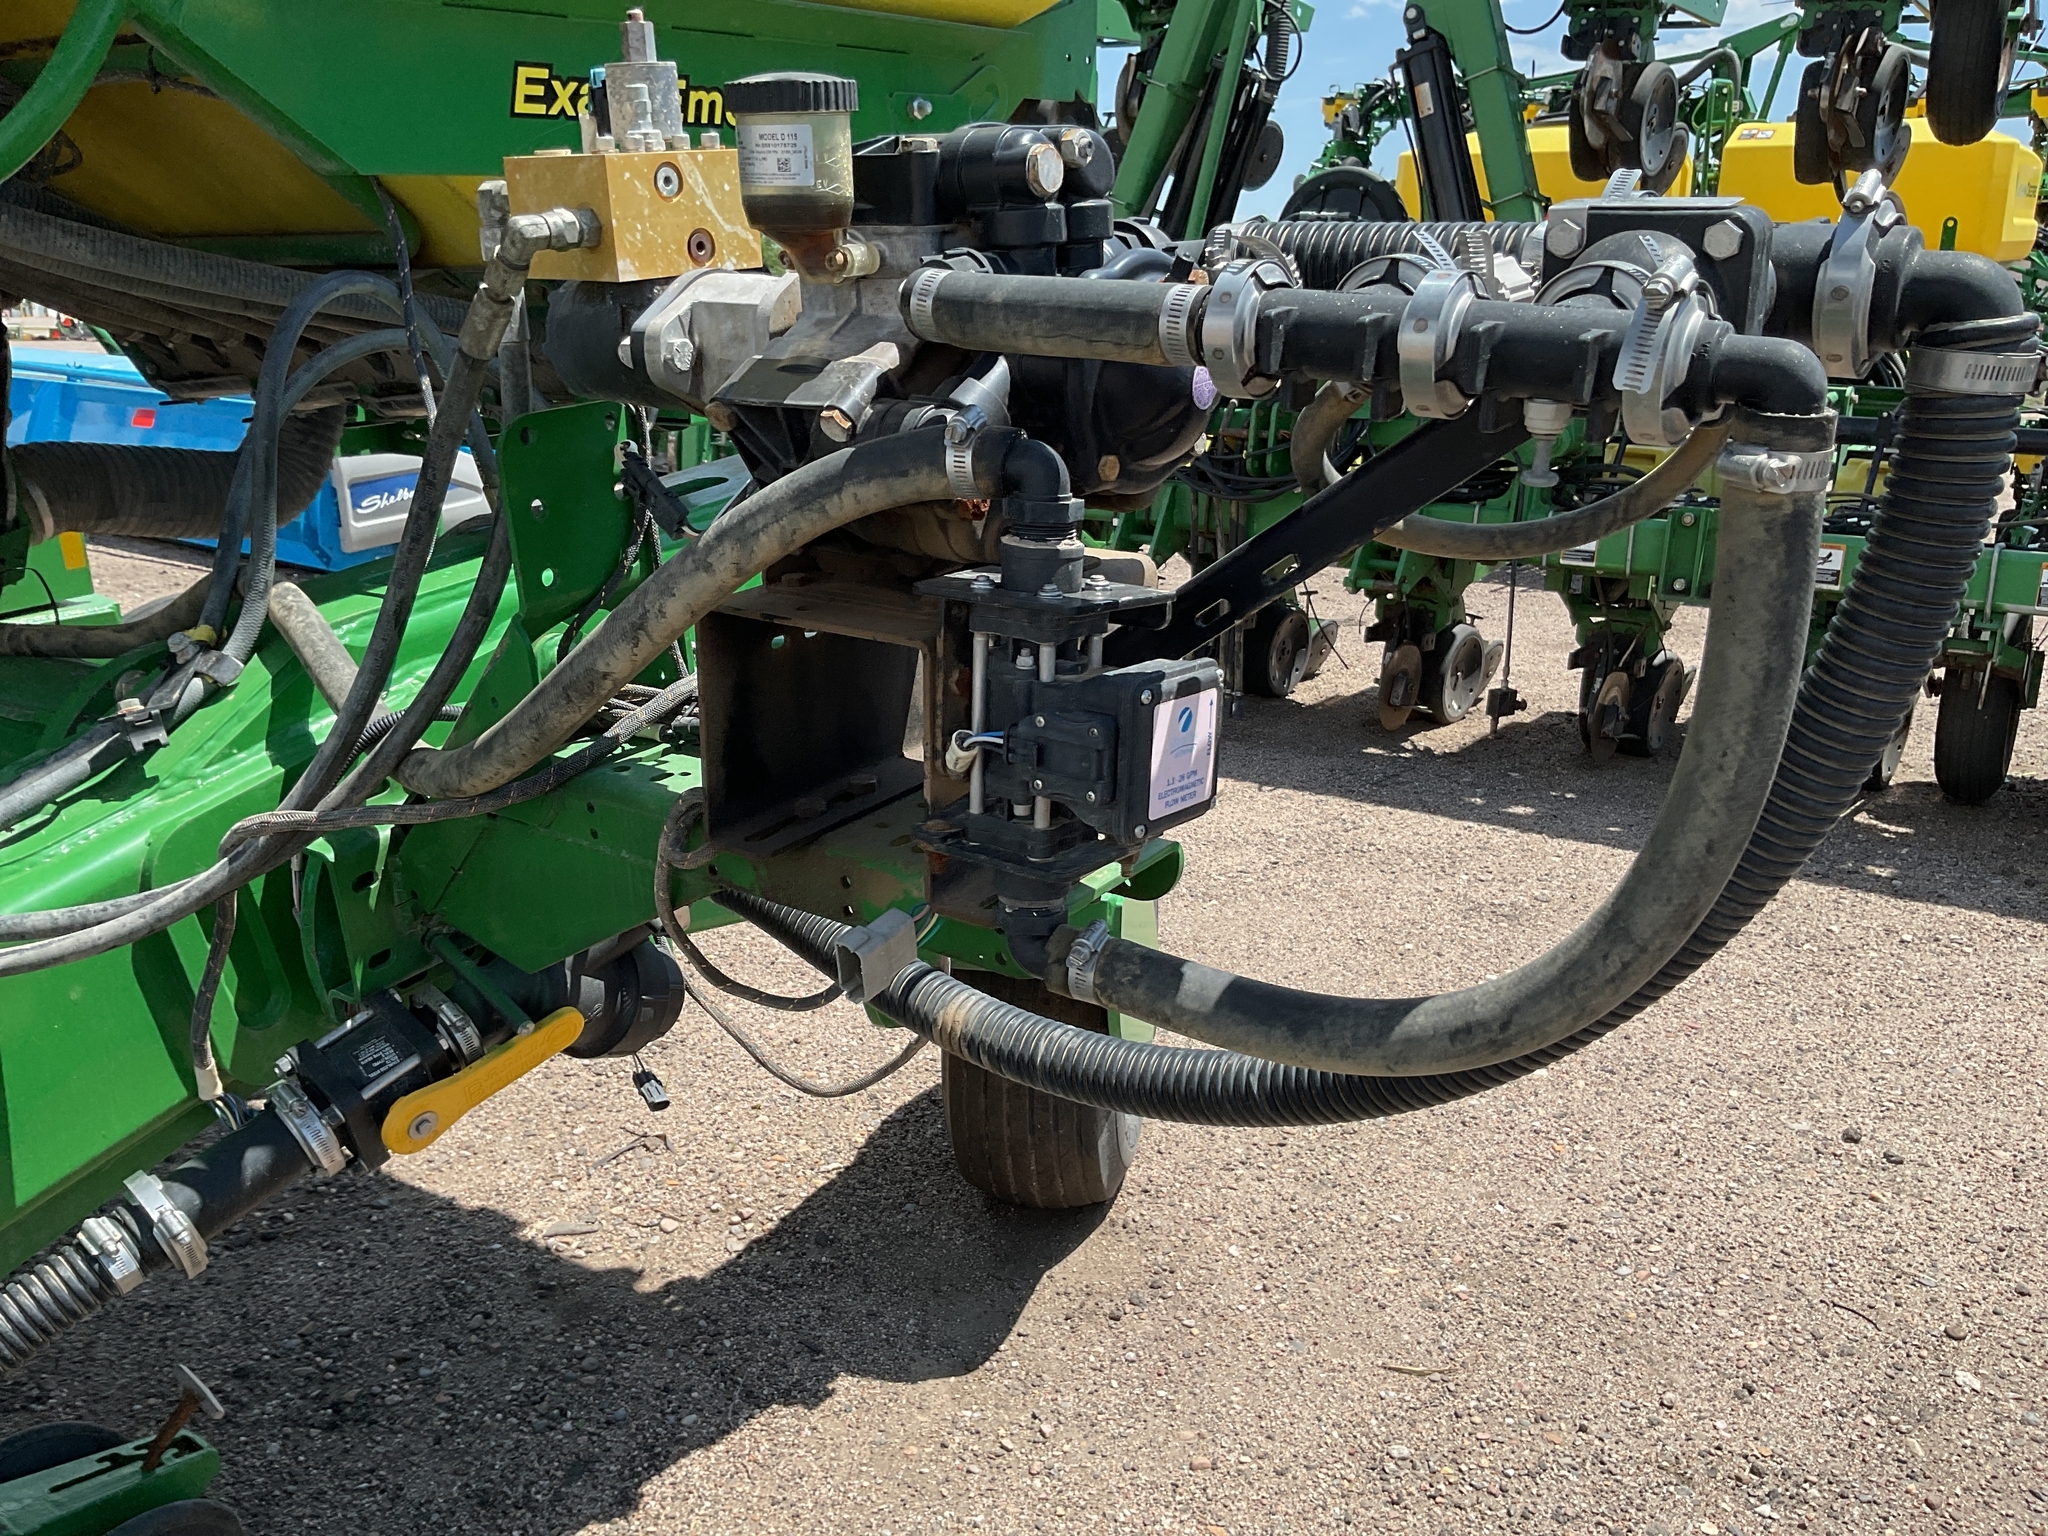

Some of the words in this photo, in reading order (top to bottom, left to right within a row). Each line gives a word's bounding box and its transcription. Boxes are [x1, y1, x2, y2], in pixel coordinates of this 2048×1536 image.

[758, 133, 779, 141] MODEL
[787, 133, 798, 141] 115
[1158, 777, 1205, 800] ELECTROMAGNETIC
[1164, 798, 1180, 809] FLOW
[1180, 790, 1197, 803] METER
